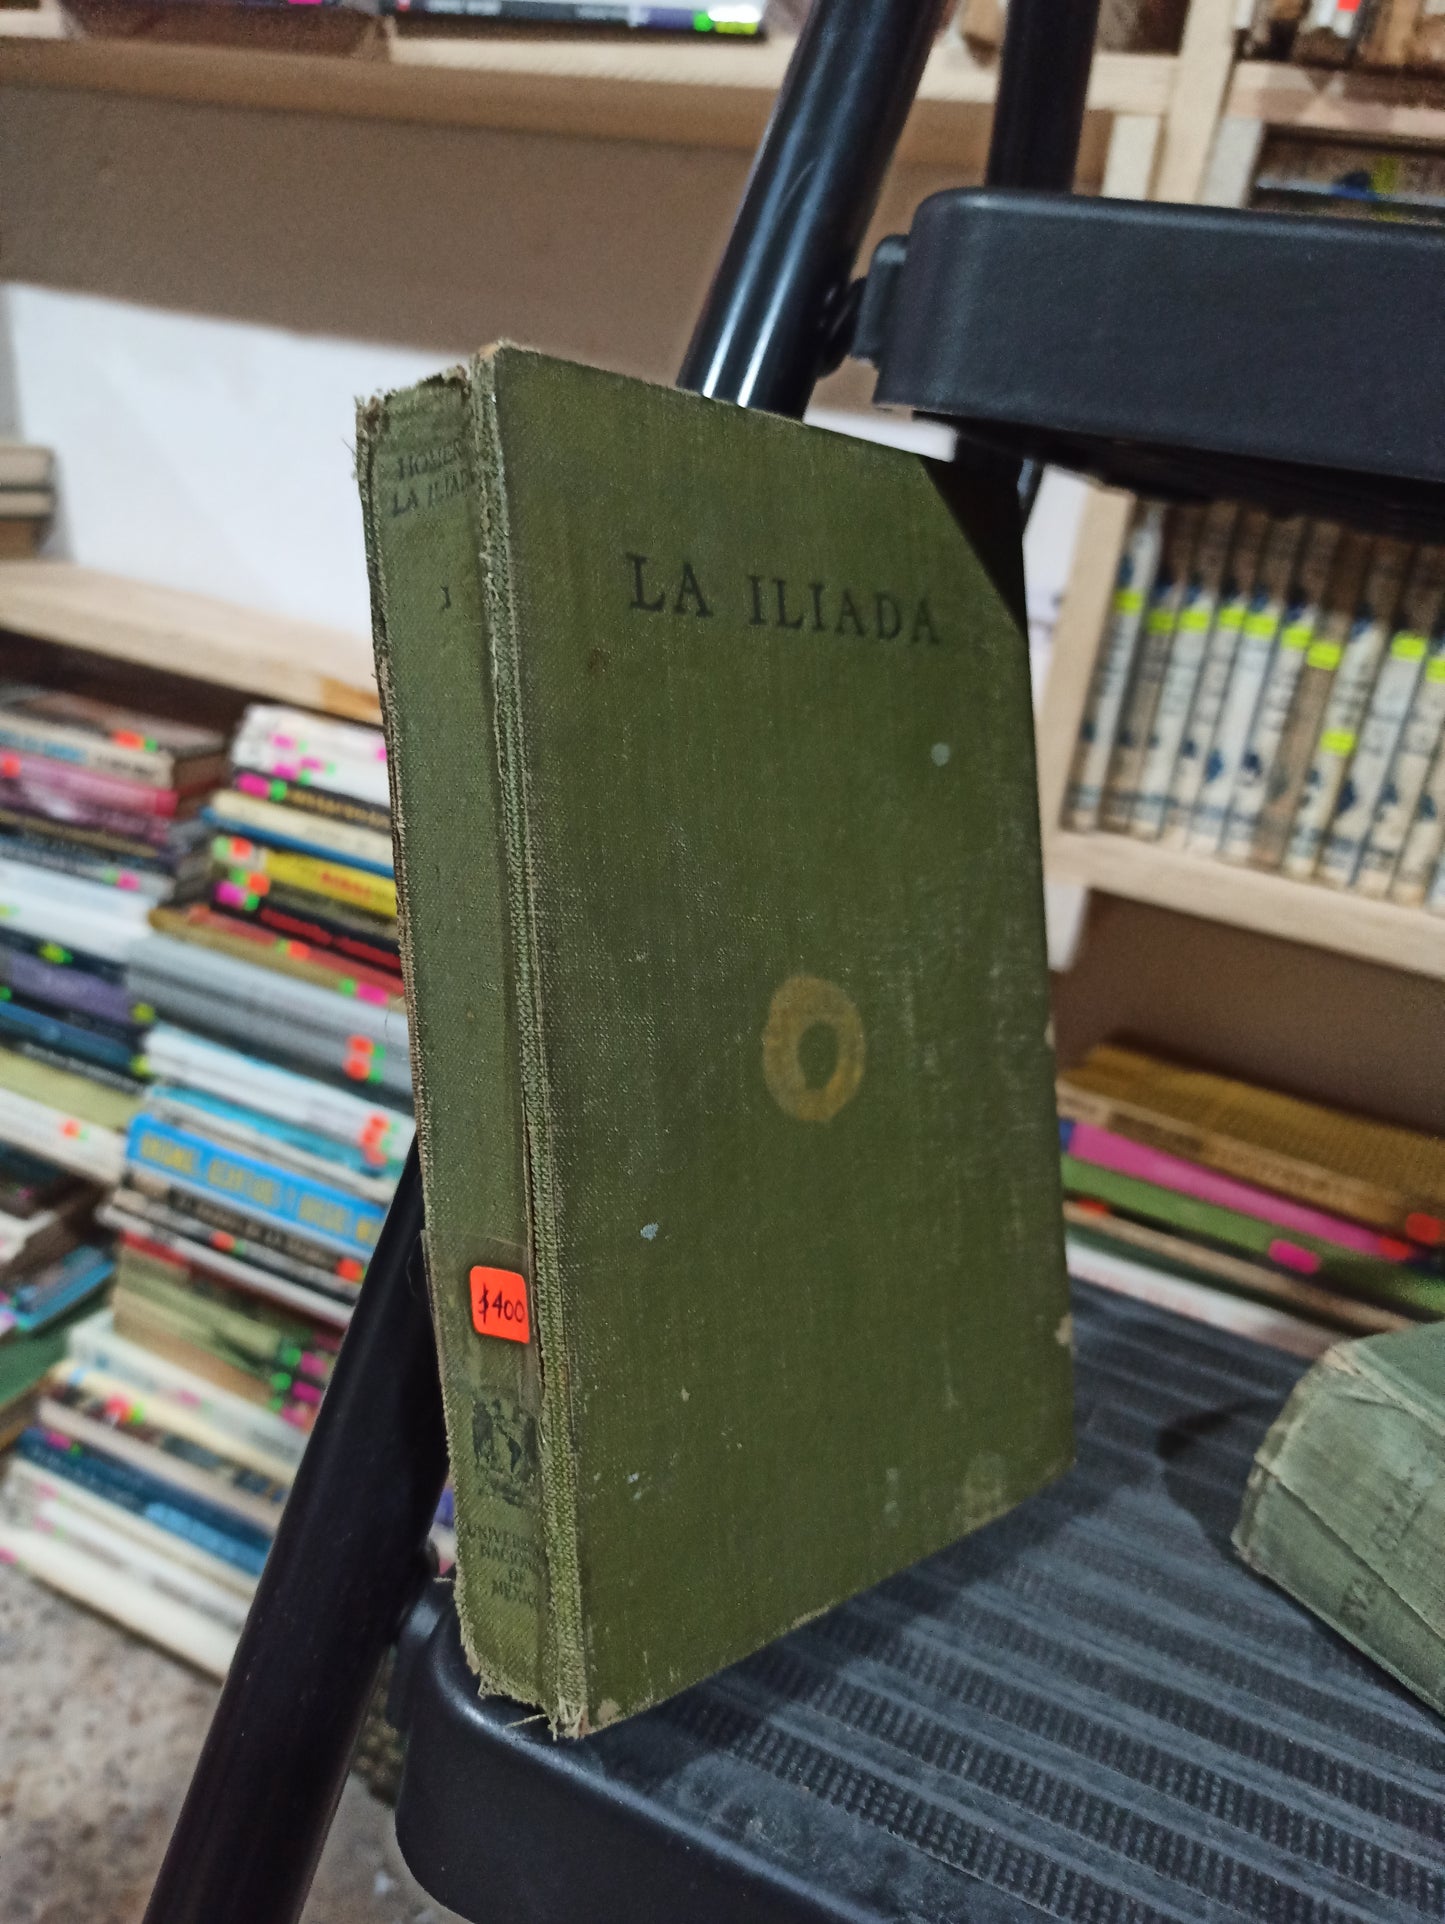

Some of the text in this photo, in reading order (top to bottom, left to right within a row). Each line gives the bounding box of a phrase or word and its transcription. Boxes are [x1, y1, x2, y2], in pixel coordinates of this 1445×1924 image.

[392, 488, 419, 518] LA
[625, 552, 941, 645] LA ILIADA
[478, 1281, 525, 1325] $400
